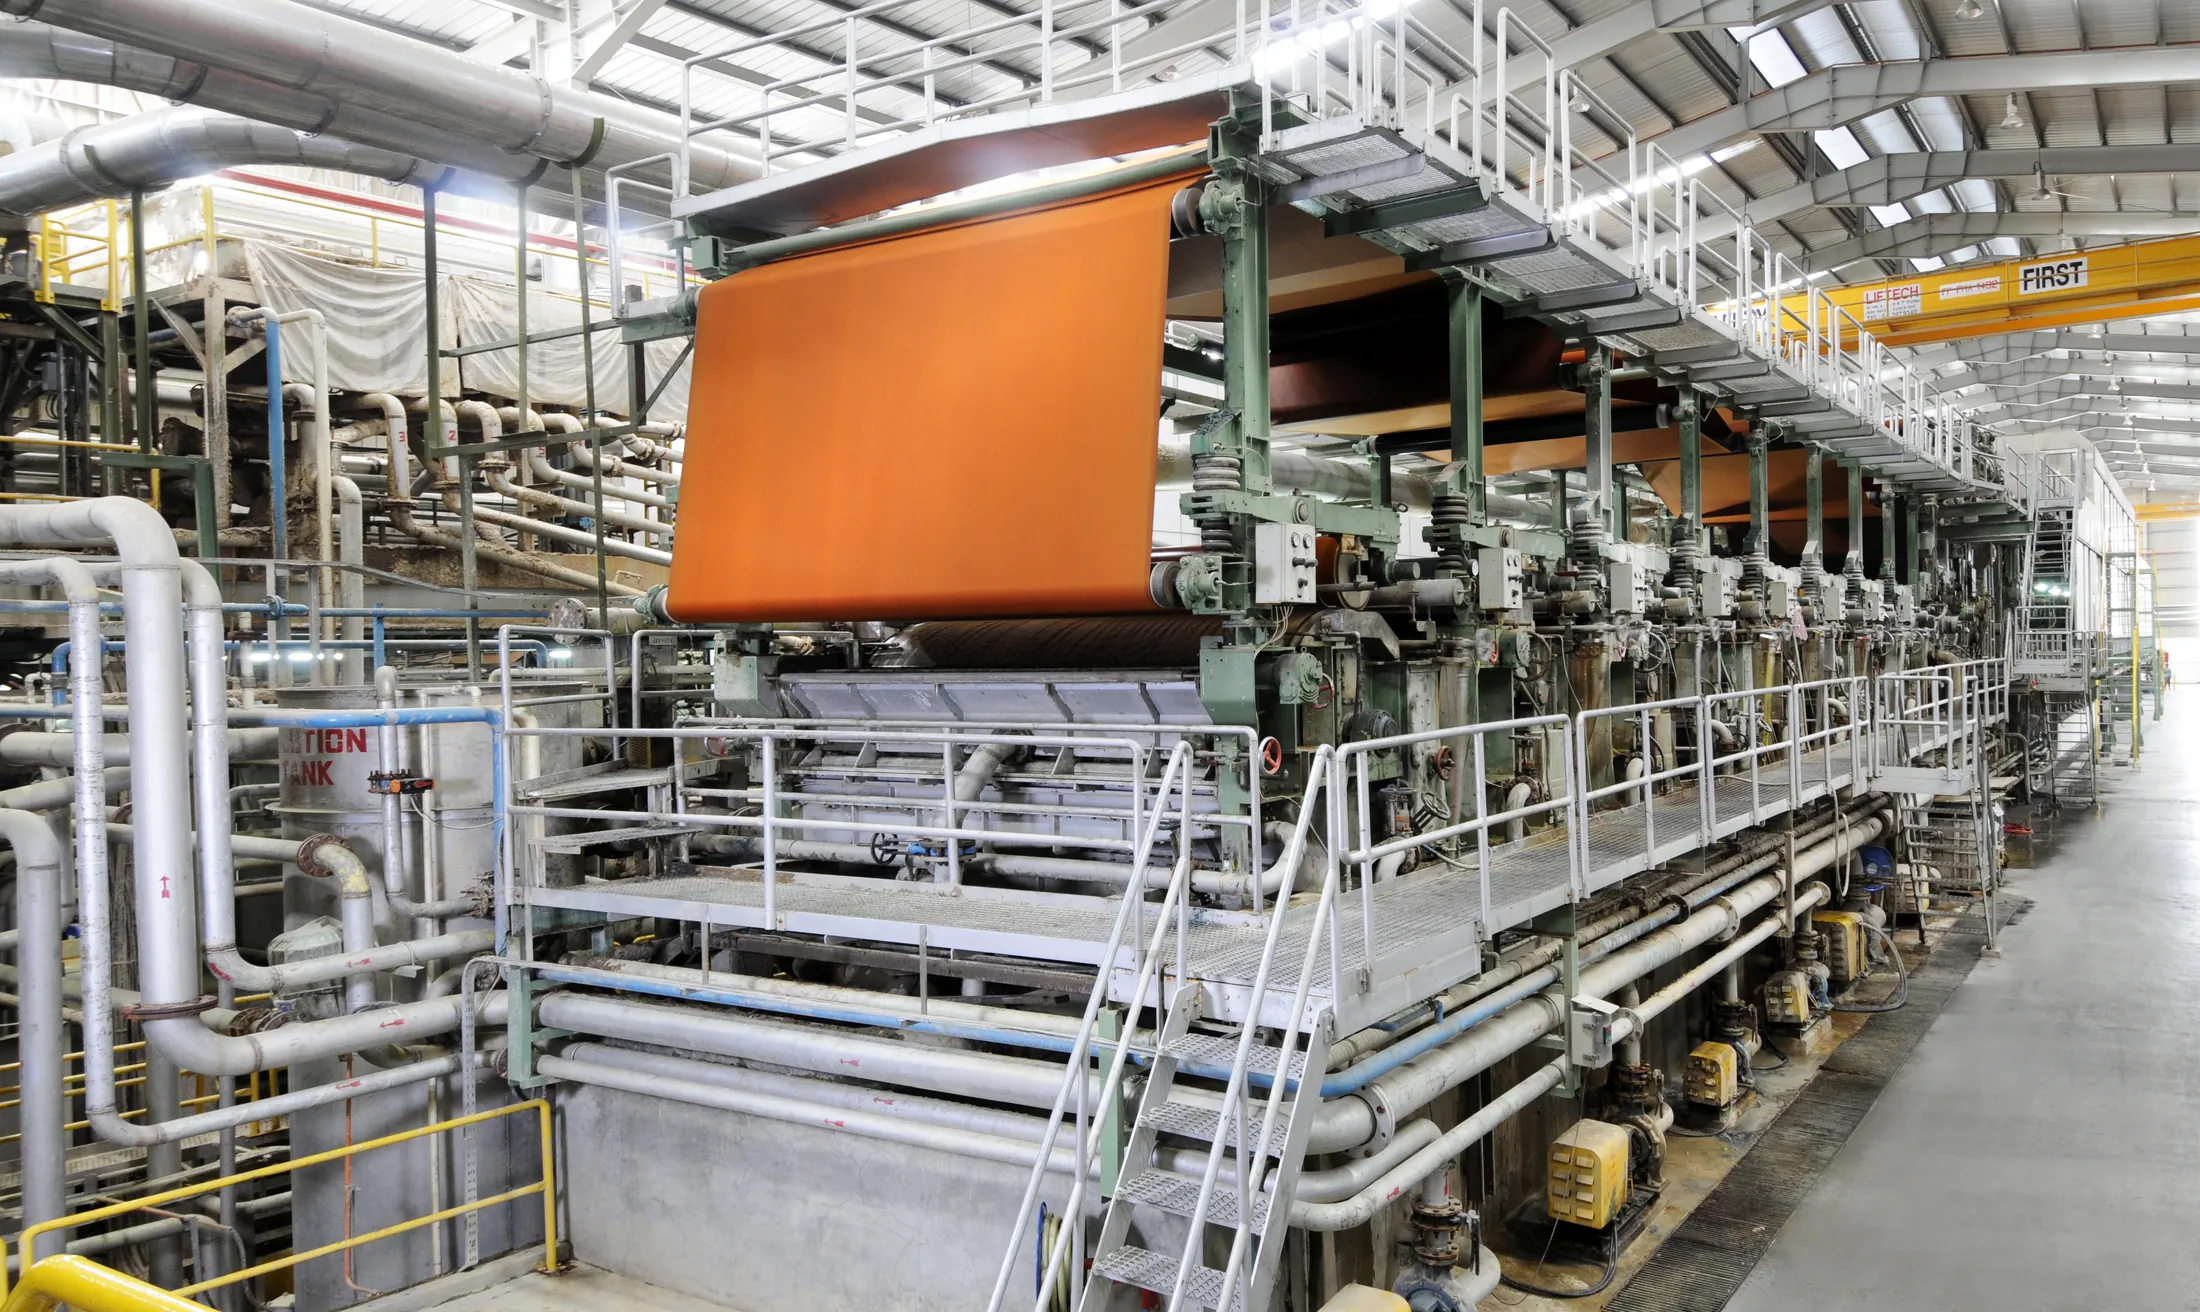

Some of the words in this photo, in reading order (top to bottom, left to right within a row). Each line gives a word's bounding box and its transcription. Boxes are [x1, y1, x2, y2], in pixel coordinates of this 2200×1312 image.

[2023, 261, 2083, 291] FIRST
[1866, 286, 1918, 304] LIFTECH
[398, 432, 406, 442] 3
[448, 430, 457, 441] 2
[283, 760, 335, 786] TANK
